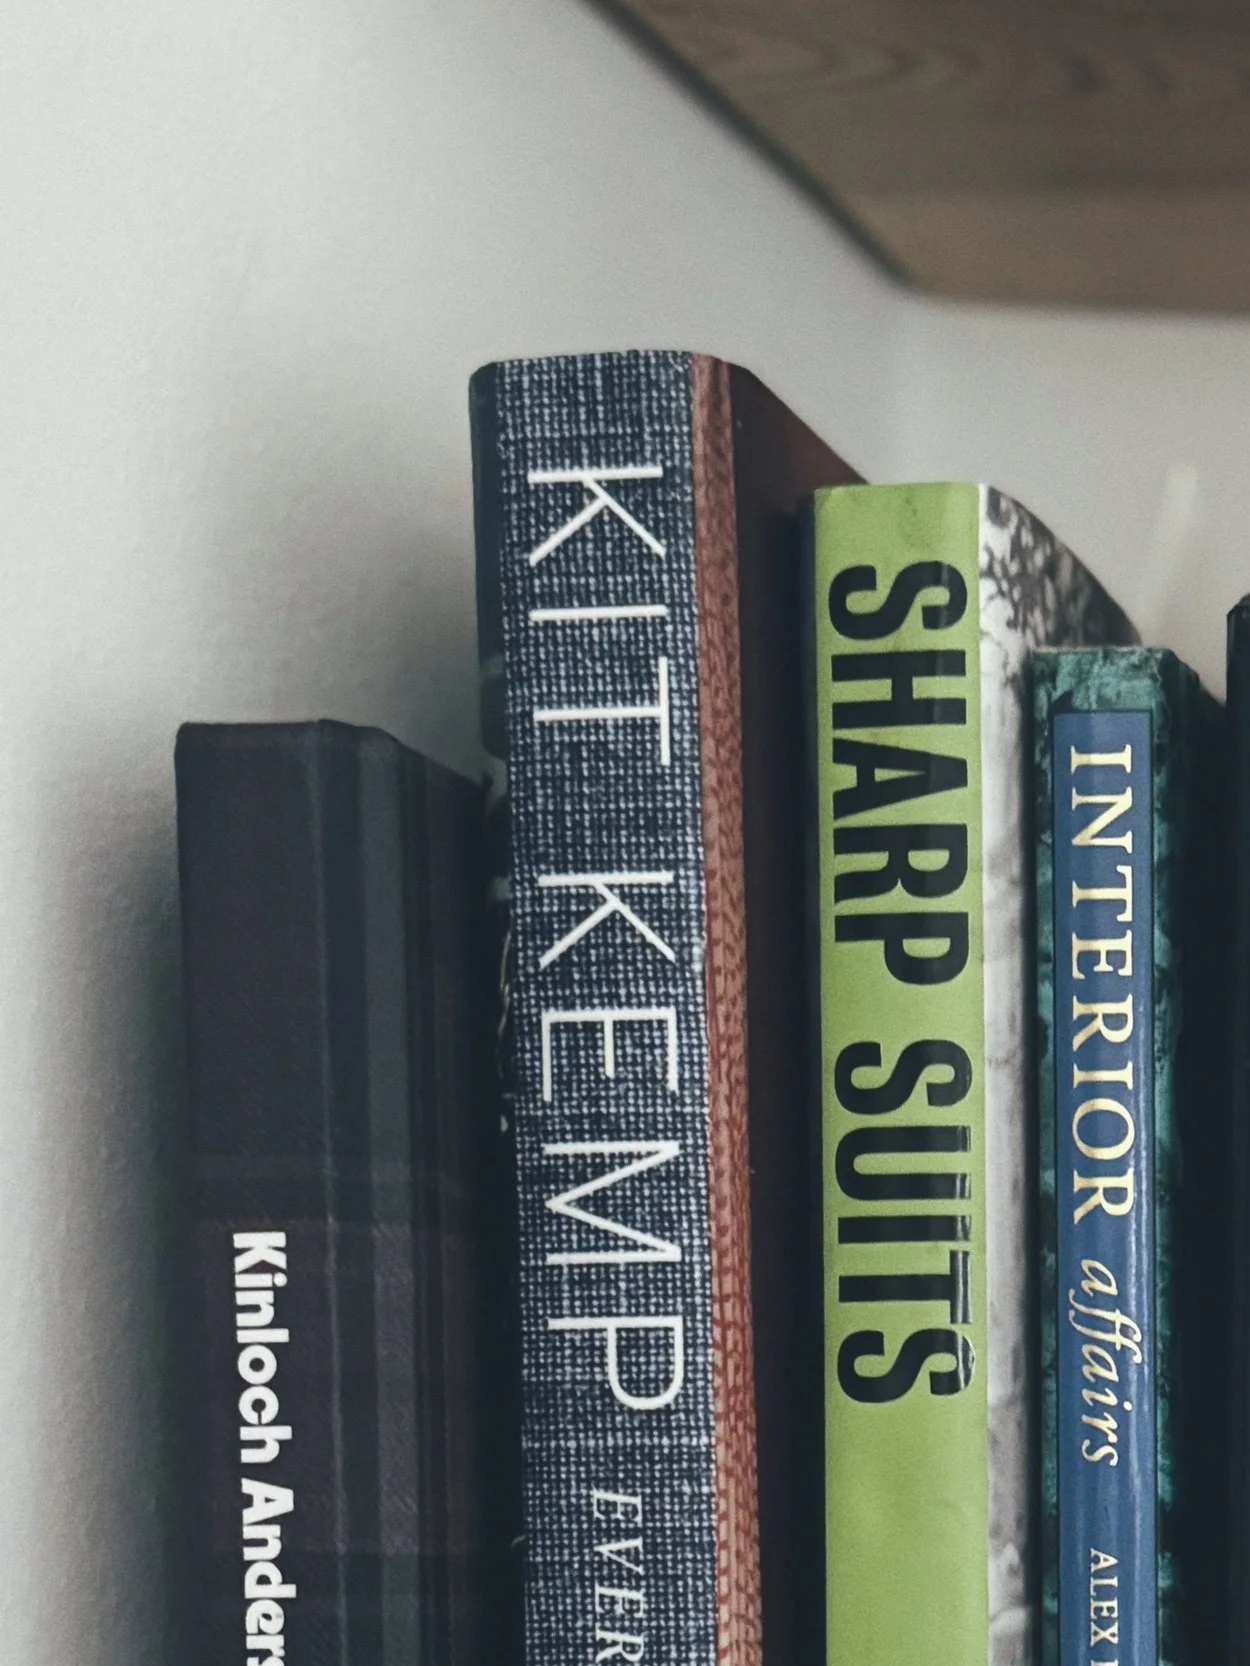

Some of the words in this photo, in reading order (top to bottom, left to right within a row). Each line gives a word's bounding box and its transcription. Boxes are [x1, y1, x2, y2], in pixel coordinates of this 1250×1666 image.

[527, 466, 670, 767] KIT
[828, 560, 970, 986] SHARP
[538, 870, 684, 1411] KEMP
[1069, 743, 1136, 1226] INTERIOR
[232, 1231, 293, 1464] Kinloch
[834, 1038, 975, 1404] SUITS
[1068, 1259, 1143, 1467] affairs
[1089, 1548, 1120, 1646] ALEX
